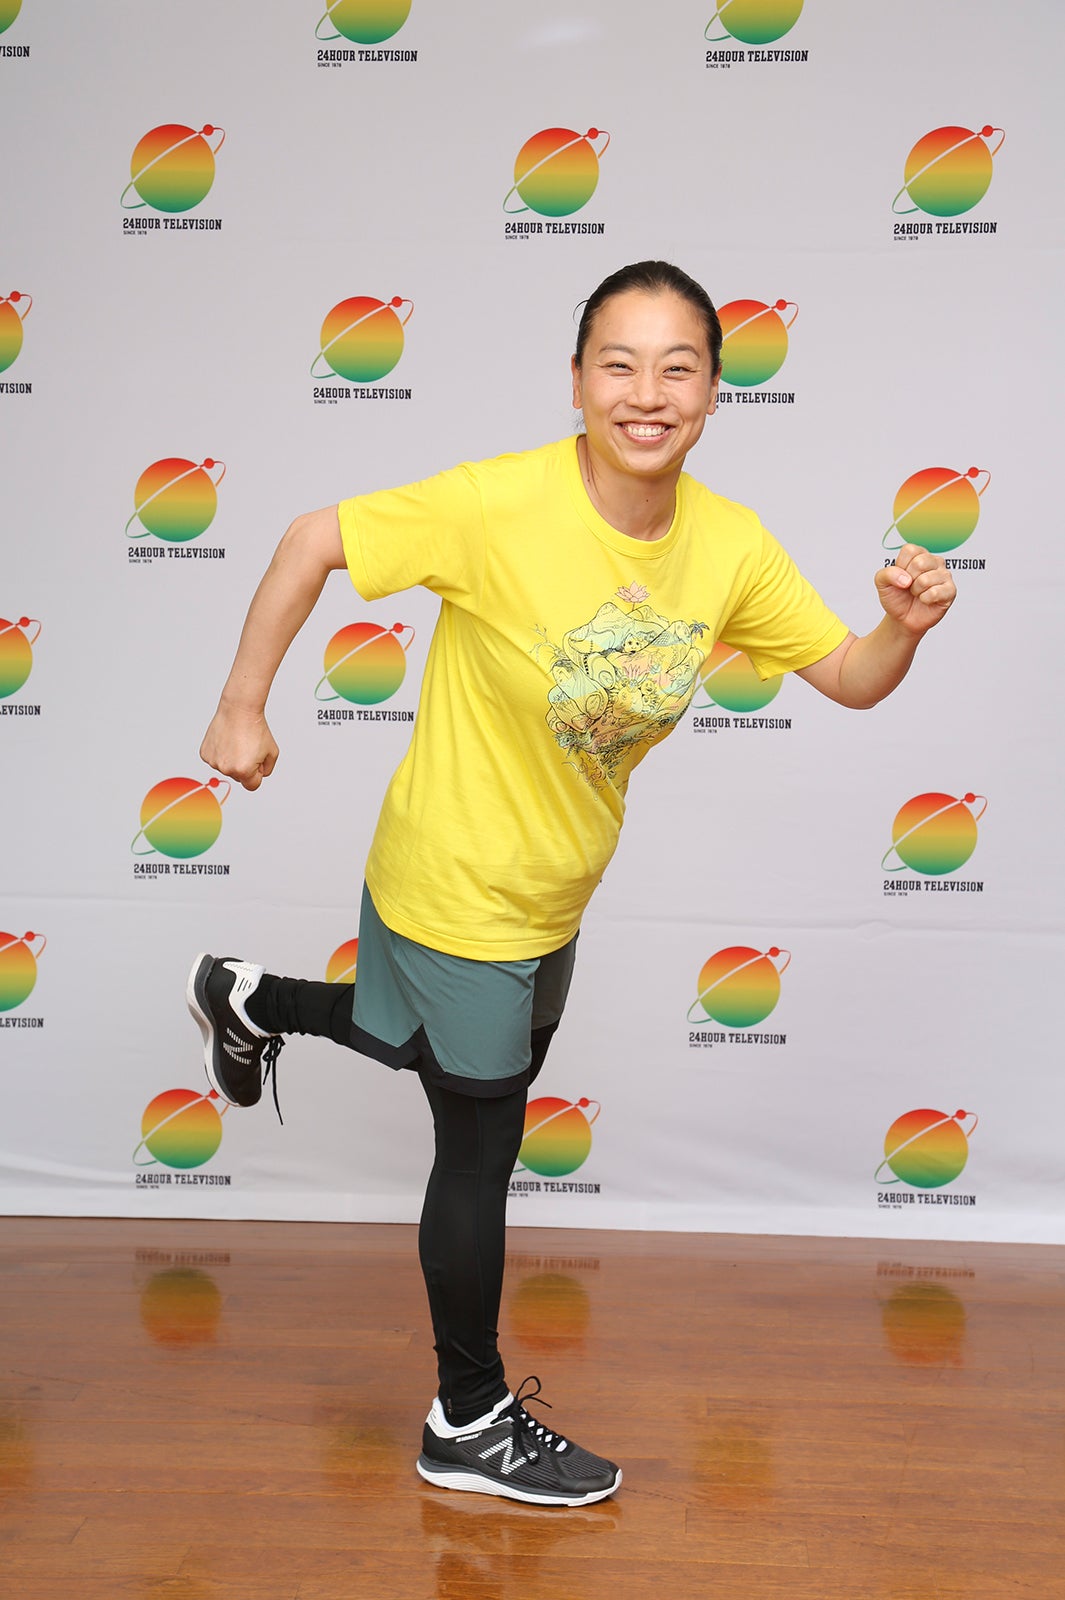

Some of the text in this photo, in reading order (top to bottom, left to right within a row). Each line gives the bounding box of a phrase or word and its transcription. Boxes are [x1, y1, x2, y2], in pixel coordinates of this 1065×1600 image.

[317, 50, 418, 61] 24HOUR TELEVISION
[706, 50, 809, 62] 24HOUR TELEVISION
[122, 218, 222, 230] 24HOUR TELEVISION
[505, 223, 605, 234] 24HOUR TELEVISION
[894, 222, 997, 234] 24HOUR TELEVISION
[313, 388, 411, 399] 24HOUR TELEVISION
[735, 393, 795, 404] TELEVISION
[128, 547, 225, 558] 24HOUR TELEVISION
[944, 559, 986, 569] EVISION
[0, 705, 41, 715] EVISION
[318, 710, 414, 721] 24HOUR TELEVISION
[693, 717, 791, 729] 24HOUR TELEVISION
[134, 864, 230, 875] 24HOUR TELEVISION
[884, 880, 983, 892] 24HOUR TELEVISION
[689, 1032, 786, 1044] 24HOUR TELEVISION
[136, 1174, 231, 1186] 24HOUR TELEVISION
[543, 1182, 600, 1194] TELEVISION
[878, 1193, 976, 1205] 24HOUR TELEVISION
